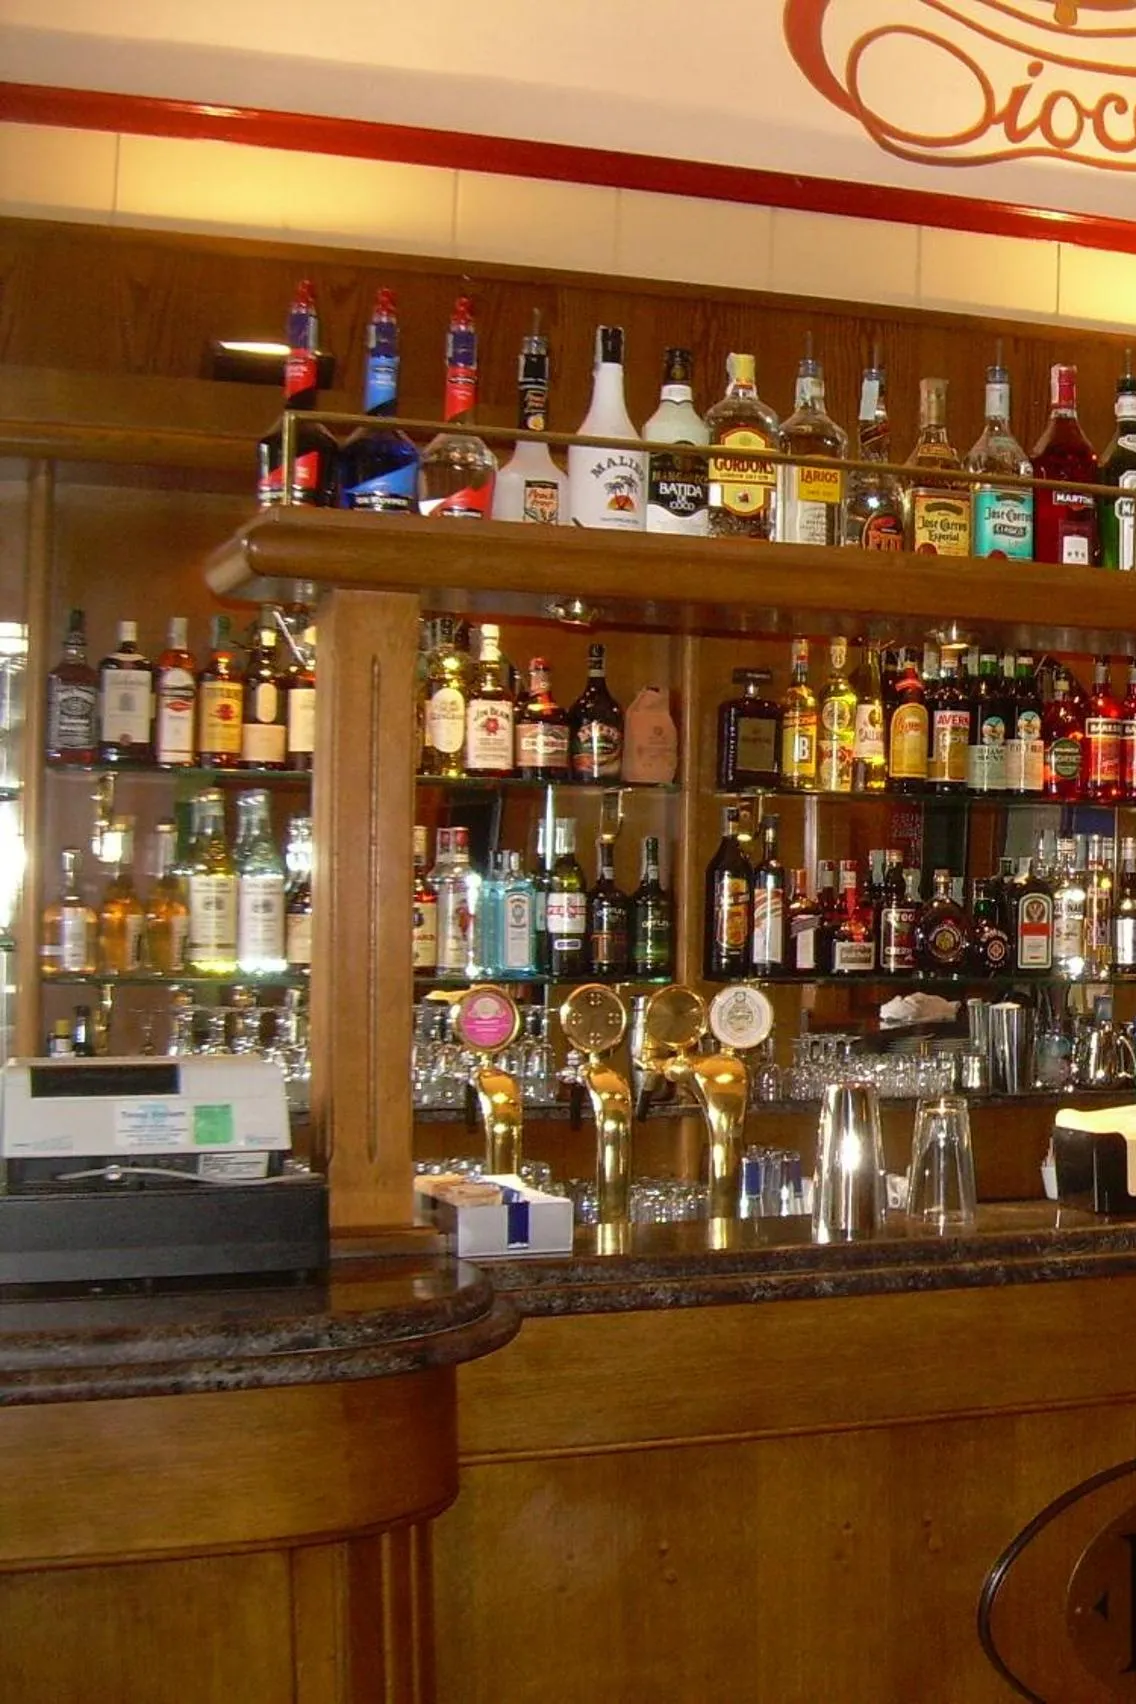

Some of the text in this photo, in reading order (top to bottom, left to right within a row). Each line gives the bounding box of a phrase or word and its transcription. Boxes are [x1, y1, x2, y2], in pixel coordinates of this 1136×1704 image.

[800, 467, 839, 484] LARIOS
[659, 482, 703, 498] BATIDA
[669, 502, 695, 511] COCO
[936, 714, 969, 725] AVERN
